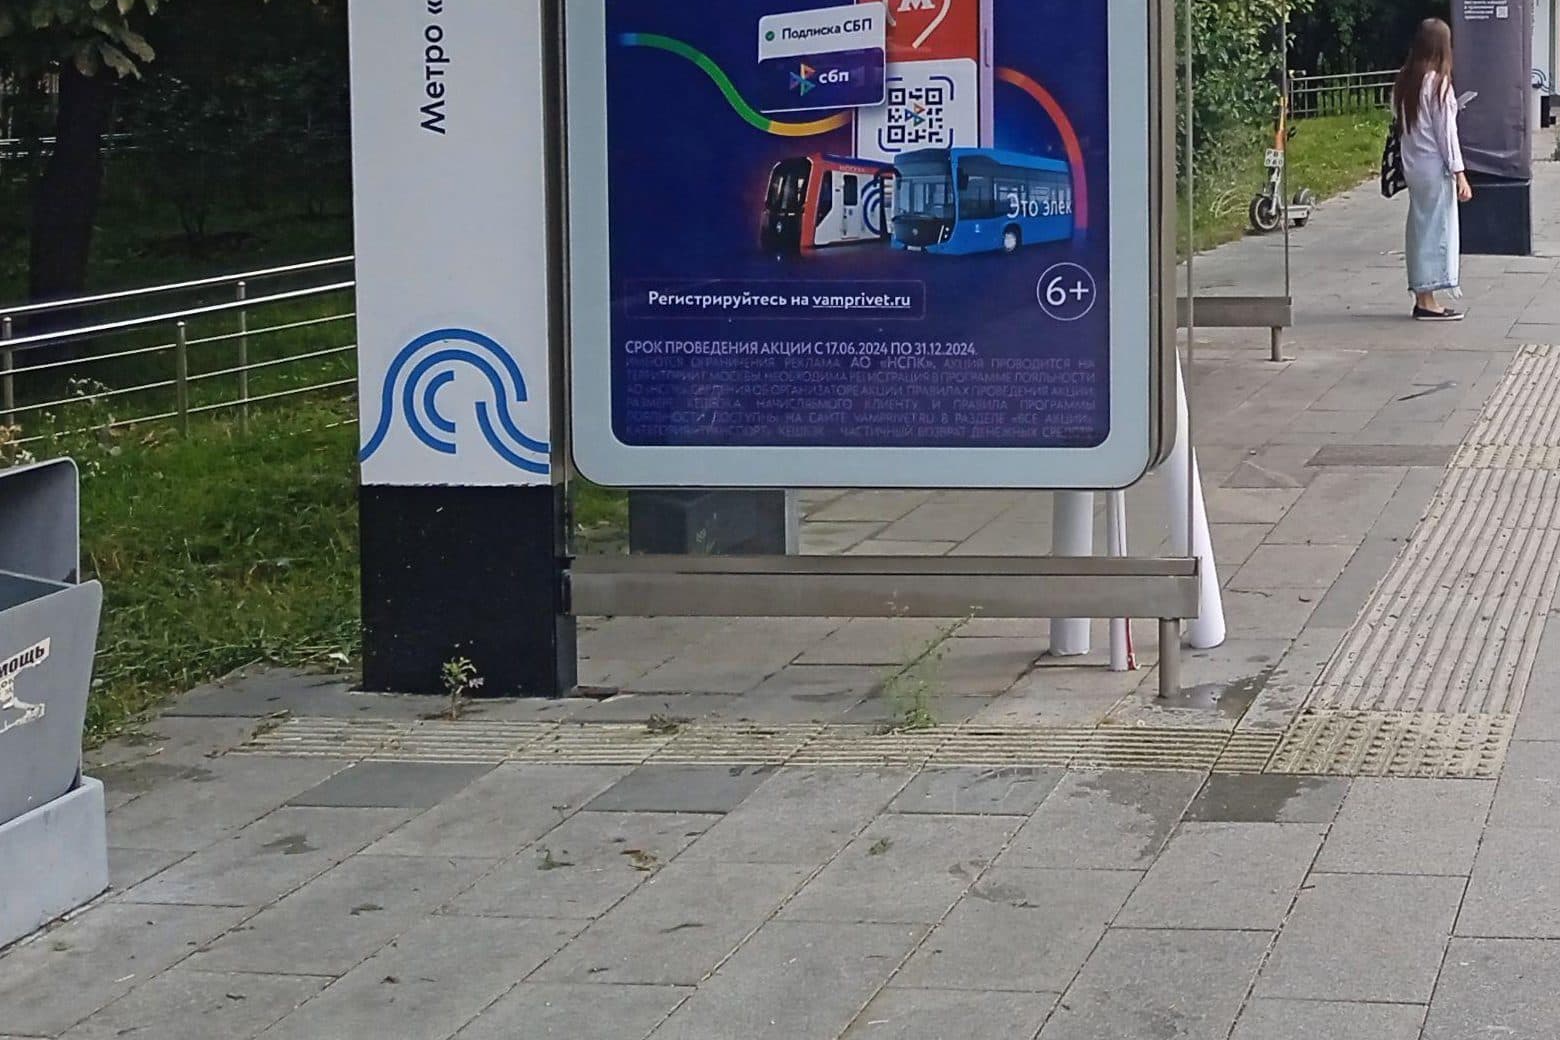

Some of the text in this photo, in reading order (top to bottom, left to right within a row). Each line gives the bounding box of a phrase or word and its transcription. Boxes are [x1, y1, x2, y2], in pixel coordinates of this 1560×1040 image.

[782, 18, 872, 41] Подписка СБП
[419, 23, 450, 134] Метро
[818, 69, 850, 84] сбп
[1007, 191, 1072, 219] Это элек
[648, 290, 910, 310] Регистрируйтесь на vamprivet.ru
[1046, 276, 1089, 306] 6+
[625, 340, 662, 355] СРОК
[665, 340, 758, 356] ПРОВЕДЕНИЯ
[760, 341, 812, 357] АКЦИИ
[814, 341, 825, 355] С
[826, 341, 888, 356] 17.06.2024
[891, 342, 912, 356] ПО
[851, 356, 871, 369] АО
